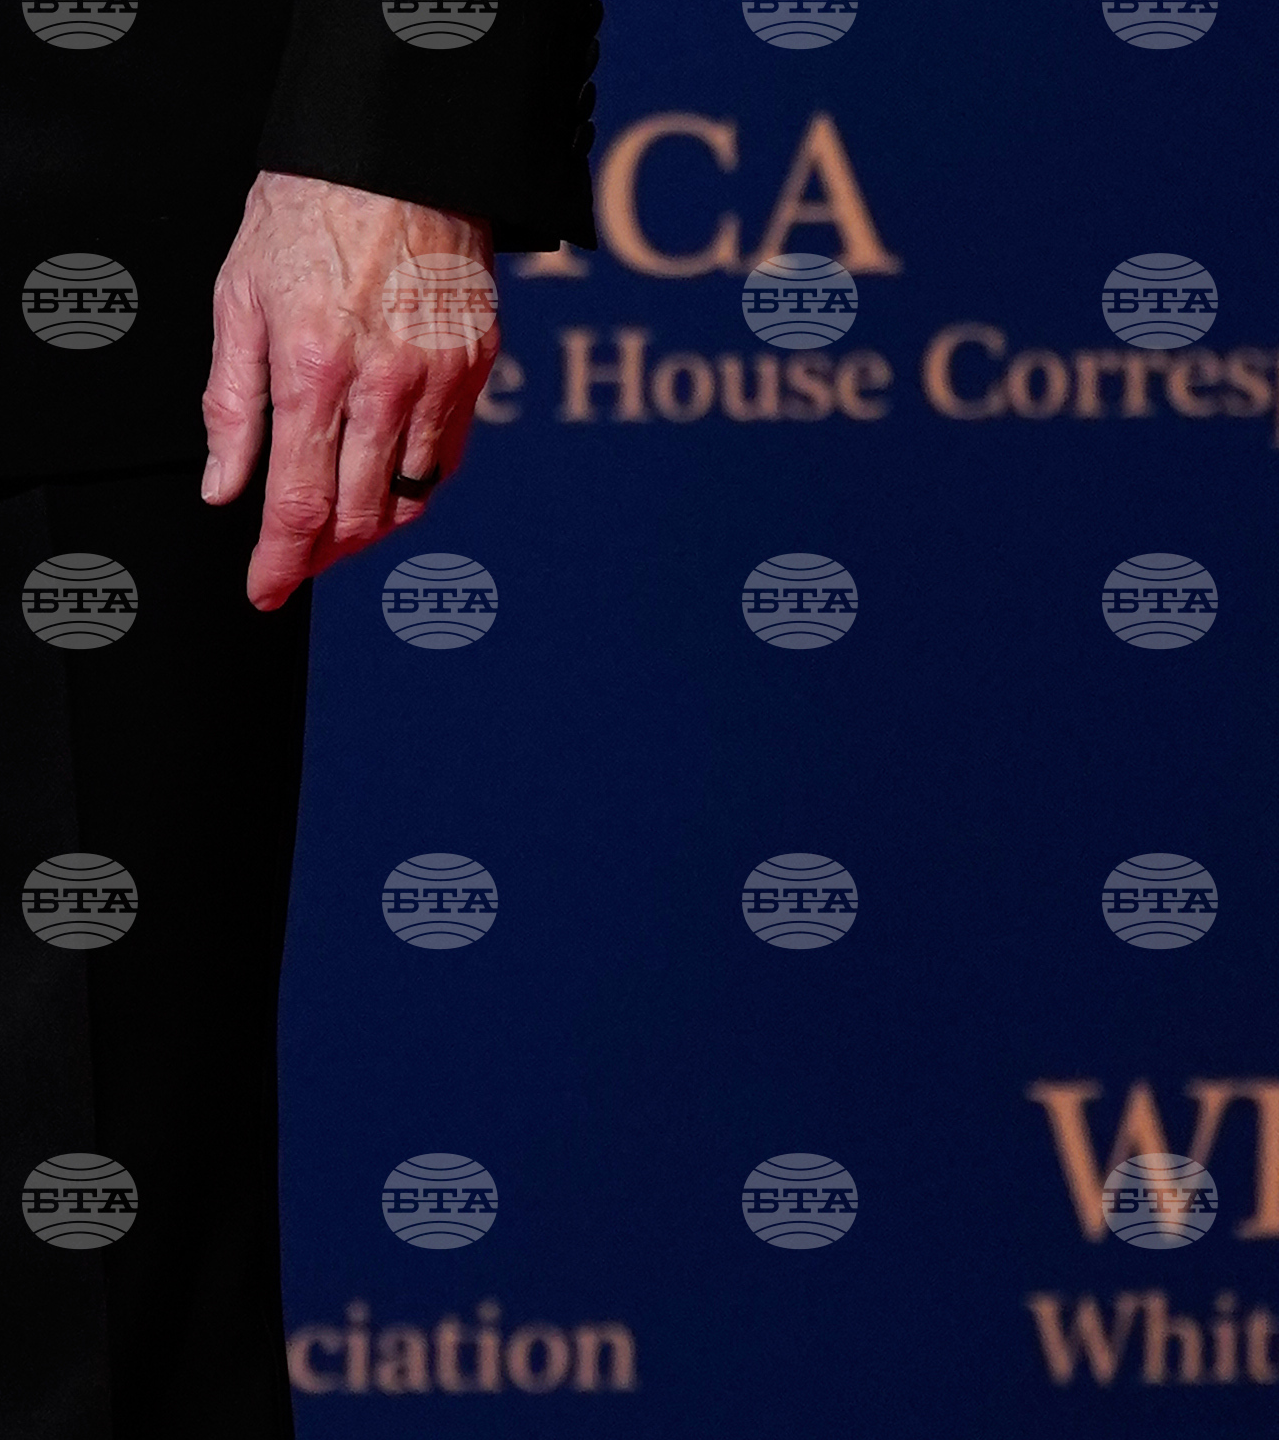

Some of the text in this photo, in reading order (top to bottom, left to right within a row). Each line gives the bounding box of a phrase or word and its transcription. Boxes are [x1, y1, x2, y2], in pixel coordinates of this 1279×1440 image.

[513, 110, 903, 278] CA
[558, 328, 895, 424] House
[921, 322, 1279, 454] Corres
[1029, 1080, 1279, 1242] W
